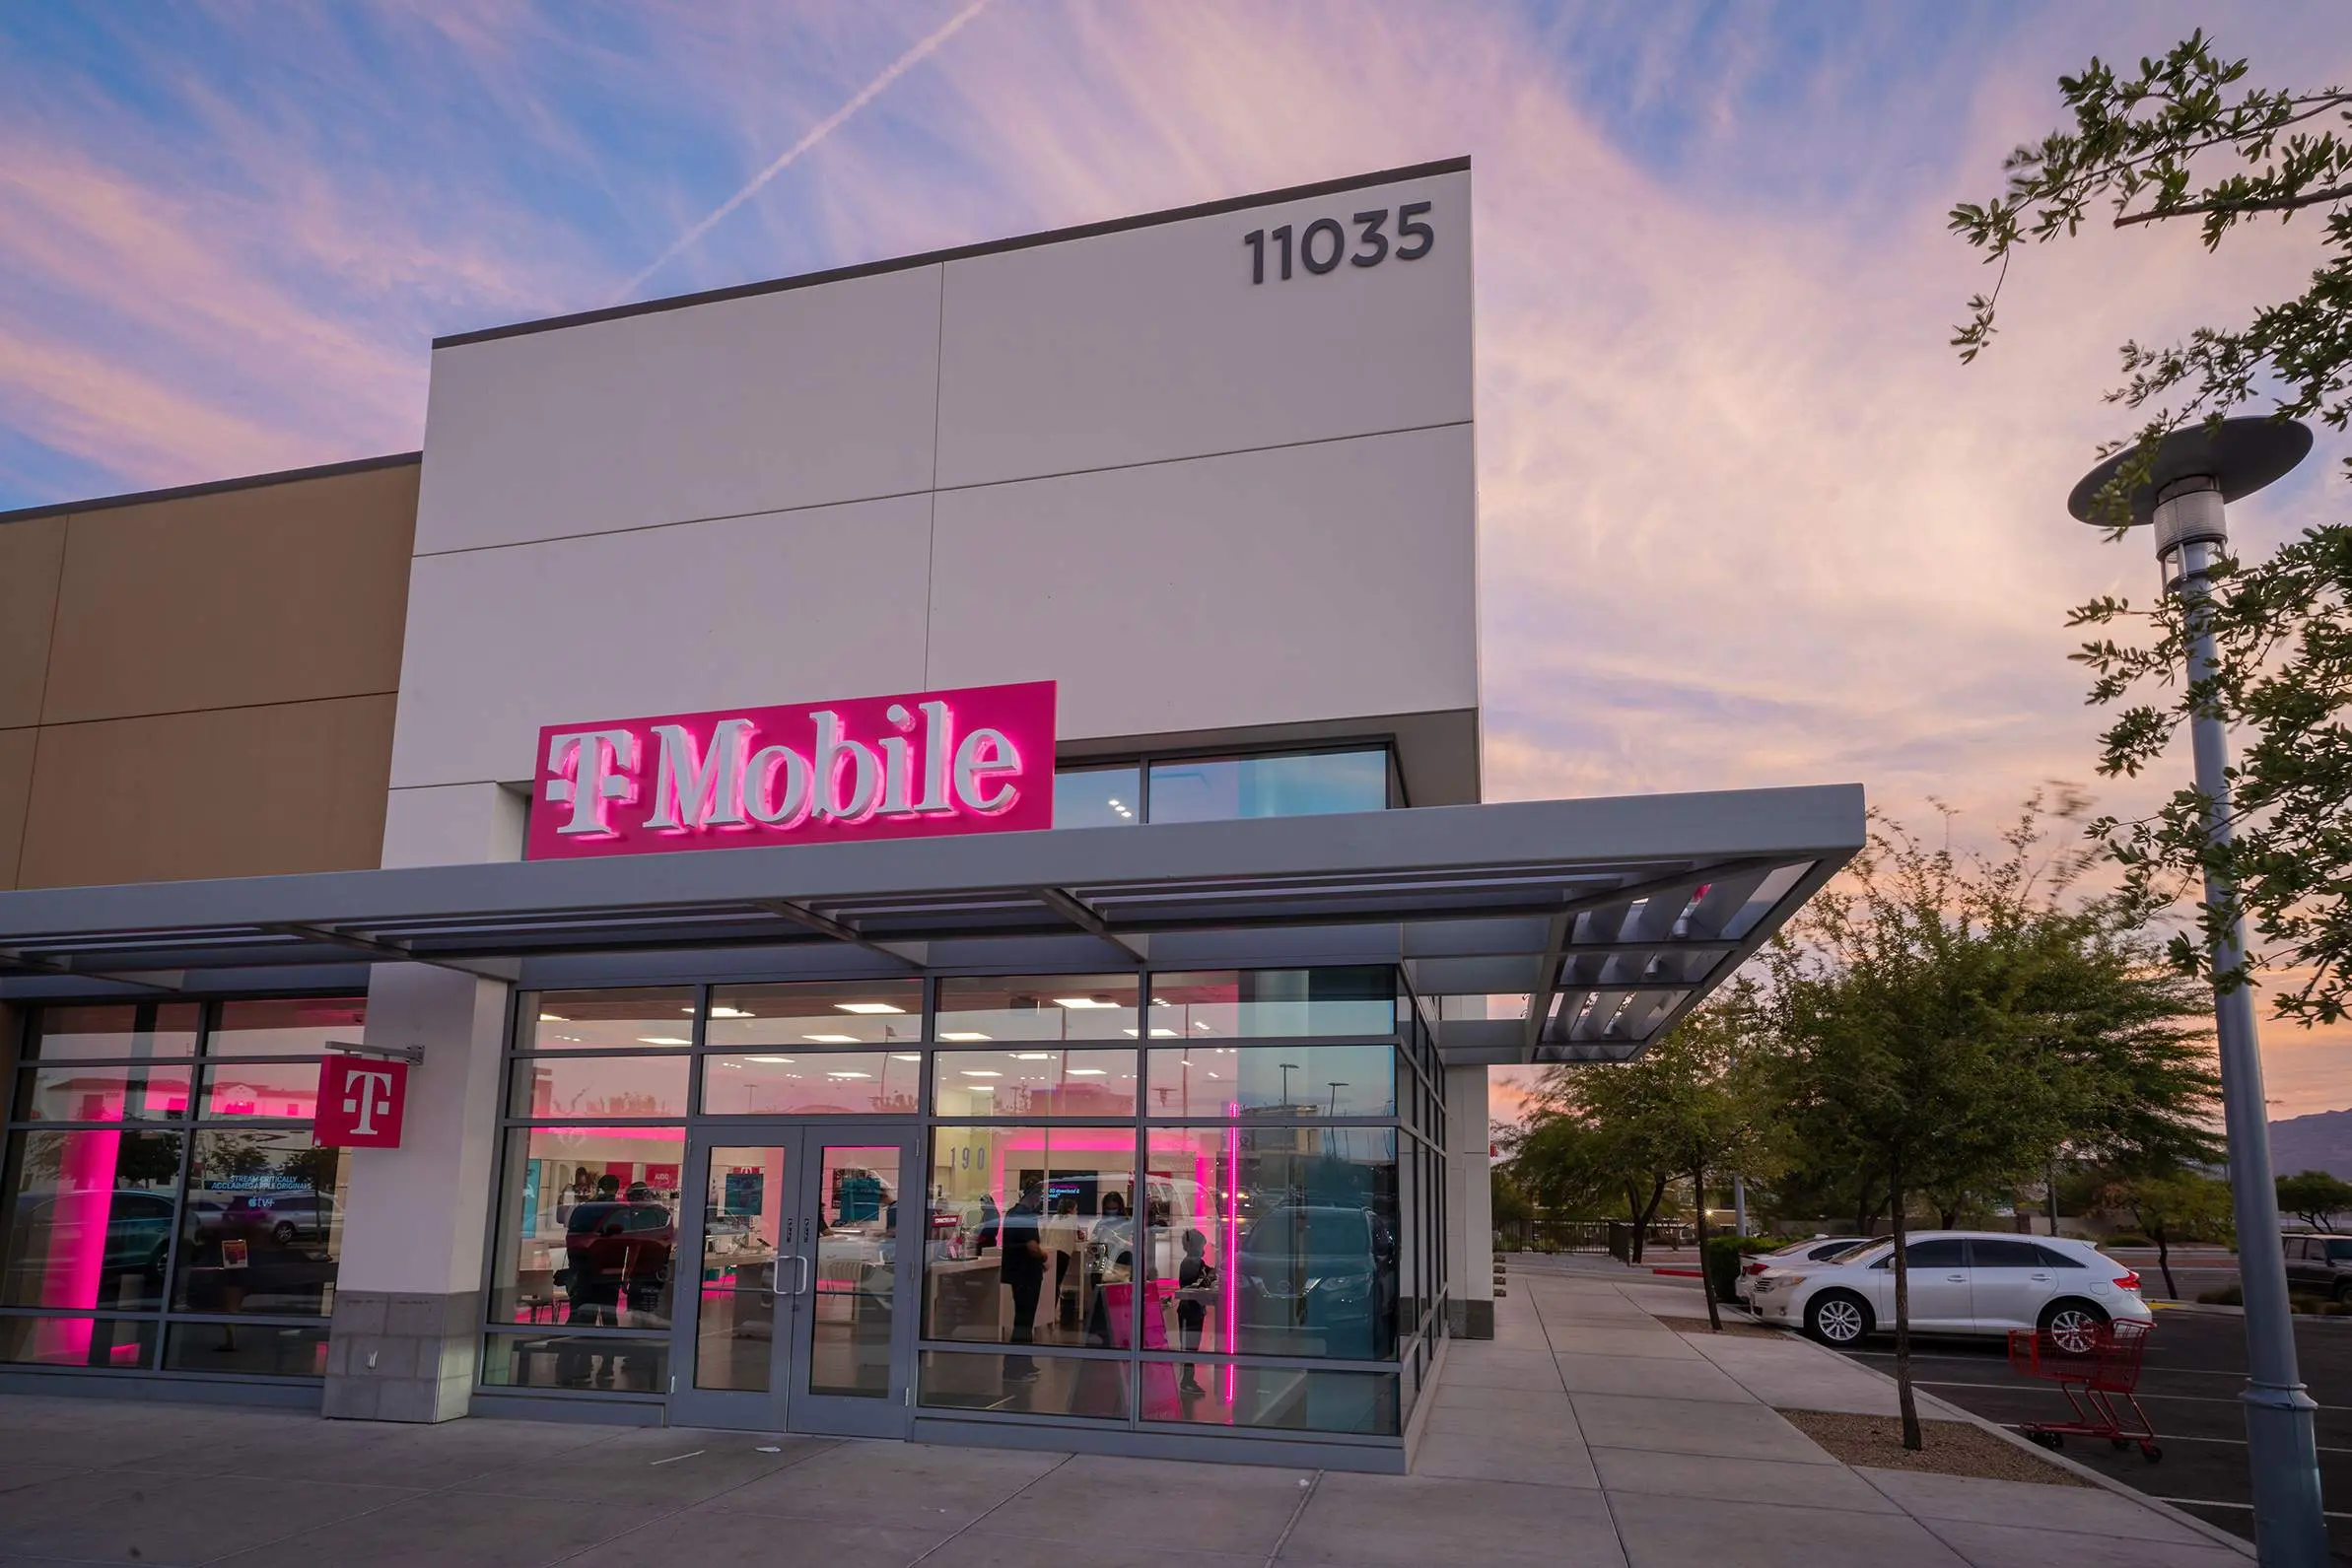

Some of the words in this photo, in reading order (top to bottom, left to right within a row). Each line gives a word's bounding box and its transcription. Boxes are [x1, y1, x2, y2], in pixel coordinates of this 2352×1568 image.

[1244, 200, 1435, 285] 11035
[643, 700, 1021, 830] Mobile
[343, 1069, 392, 1135] T
[950, 1146, 985, 1170] 190
